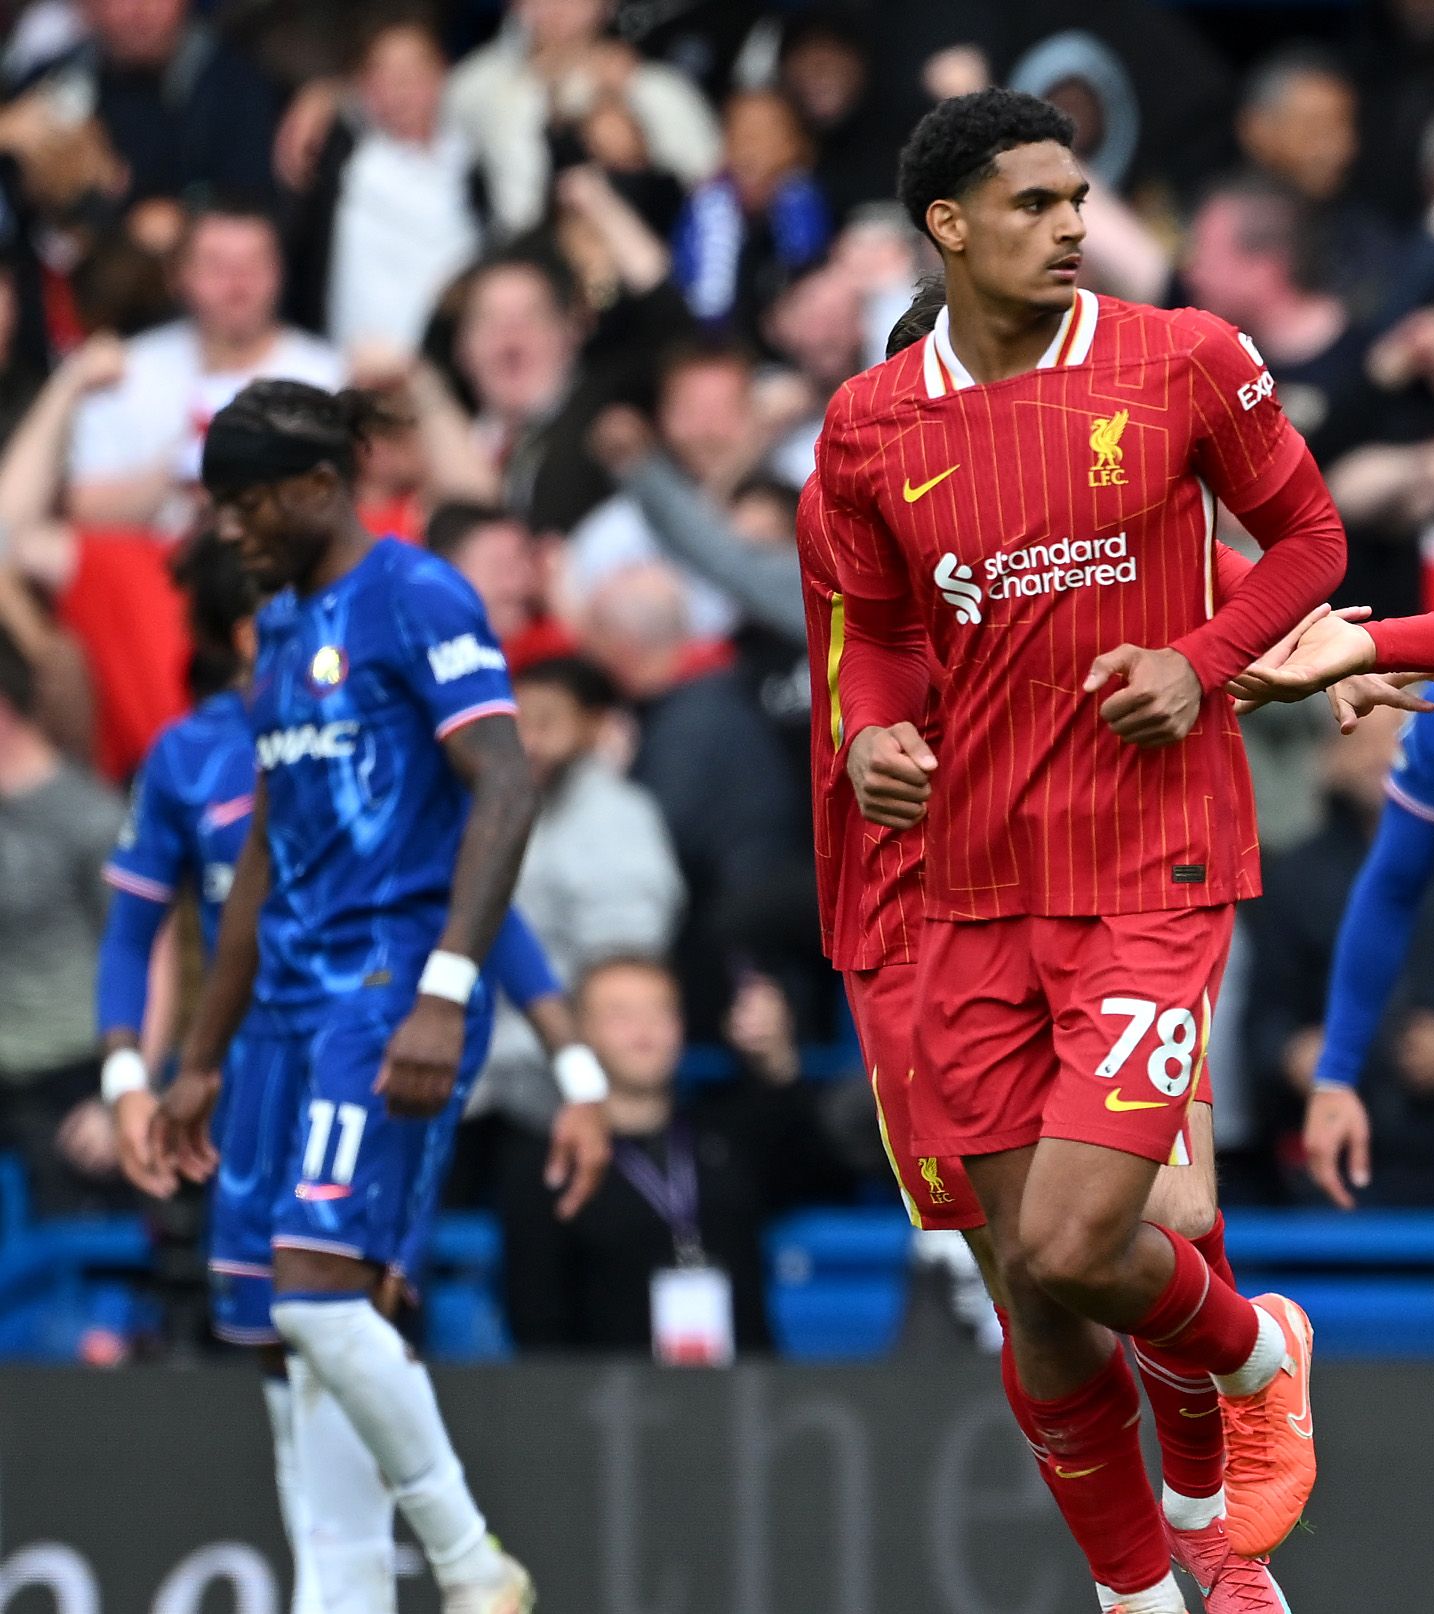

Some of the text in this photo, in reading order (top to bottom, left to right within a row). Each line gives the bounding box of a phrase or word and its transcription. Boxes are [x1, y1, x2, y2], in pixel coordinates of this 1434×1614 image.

[984, 532, 1127, 580] standard
[988, 556, 1137, 600] chartered
[1094, 997, 1197, 1097] 78
[302, 1098, 368, 1184] 11
